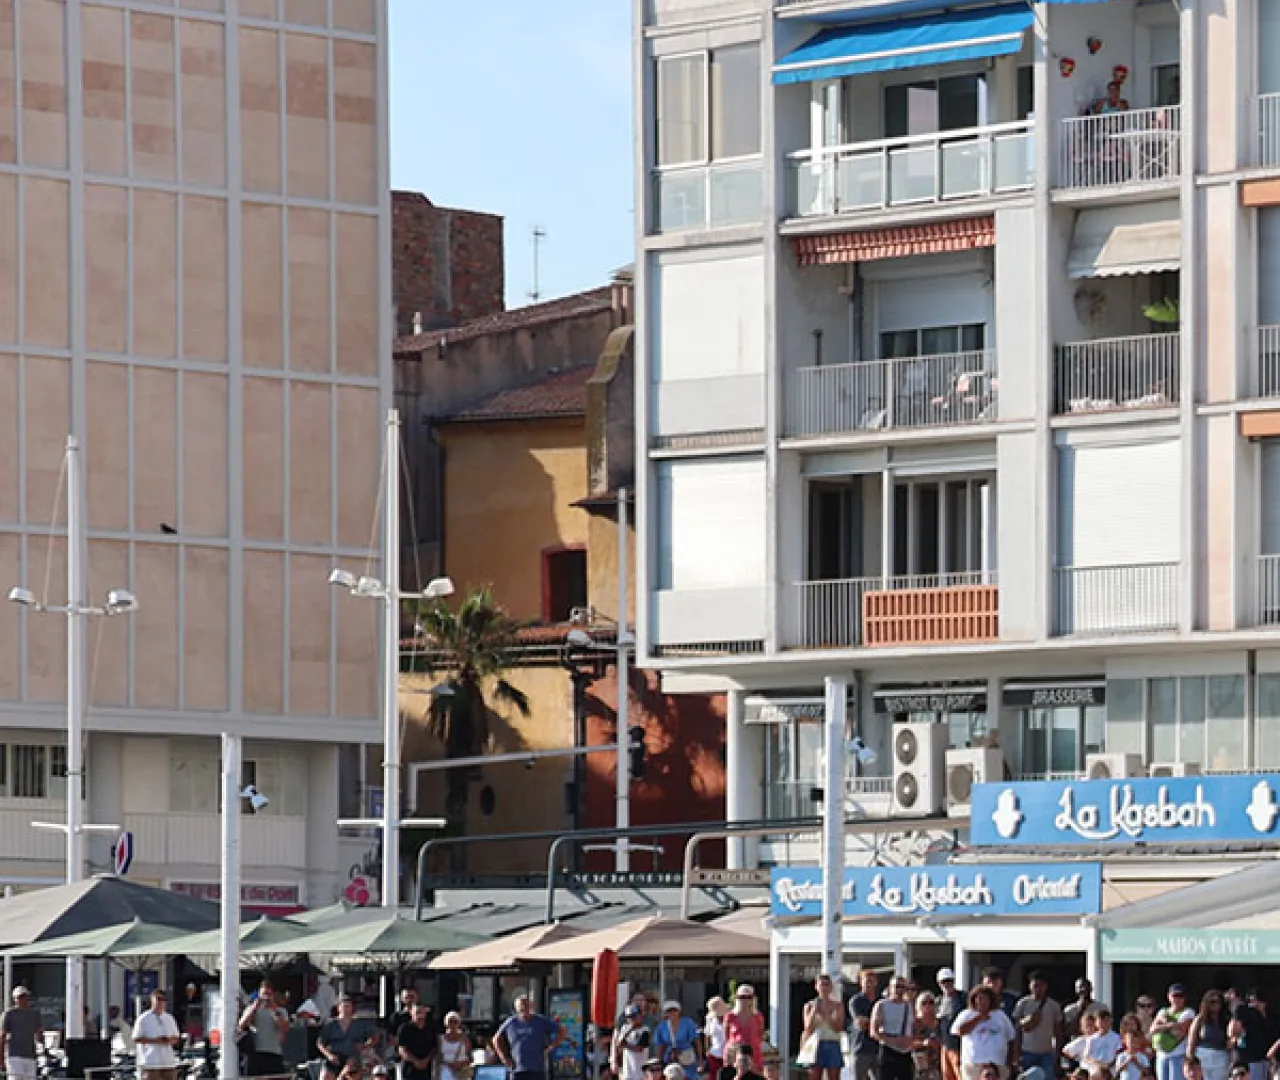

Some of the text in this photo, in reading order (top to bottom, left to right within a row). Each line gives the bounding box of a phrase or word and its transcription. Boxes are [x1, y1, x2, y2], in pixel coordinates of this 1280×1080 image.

[1032, 687, 1094, 705] BRASSERIE
[1055, 783, 1216, 838] La Kasbah
[867, 872, 905, 911] La
[907, 871, 994, 911] Kasbah
[1156, 936, 1205, 956] MAISON
